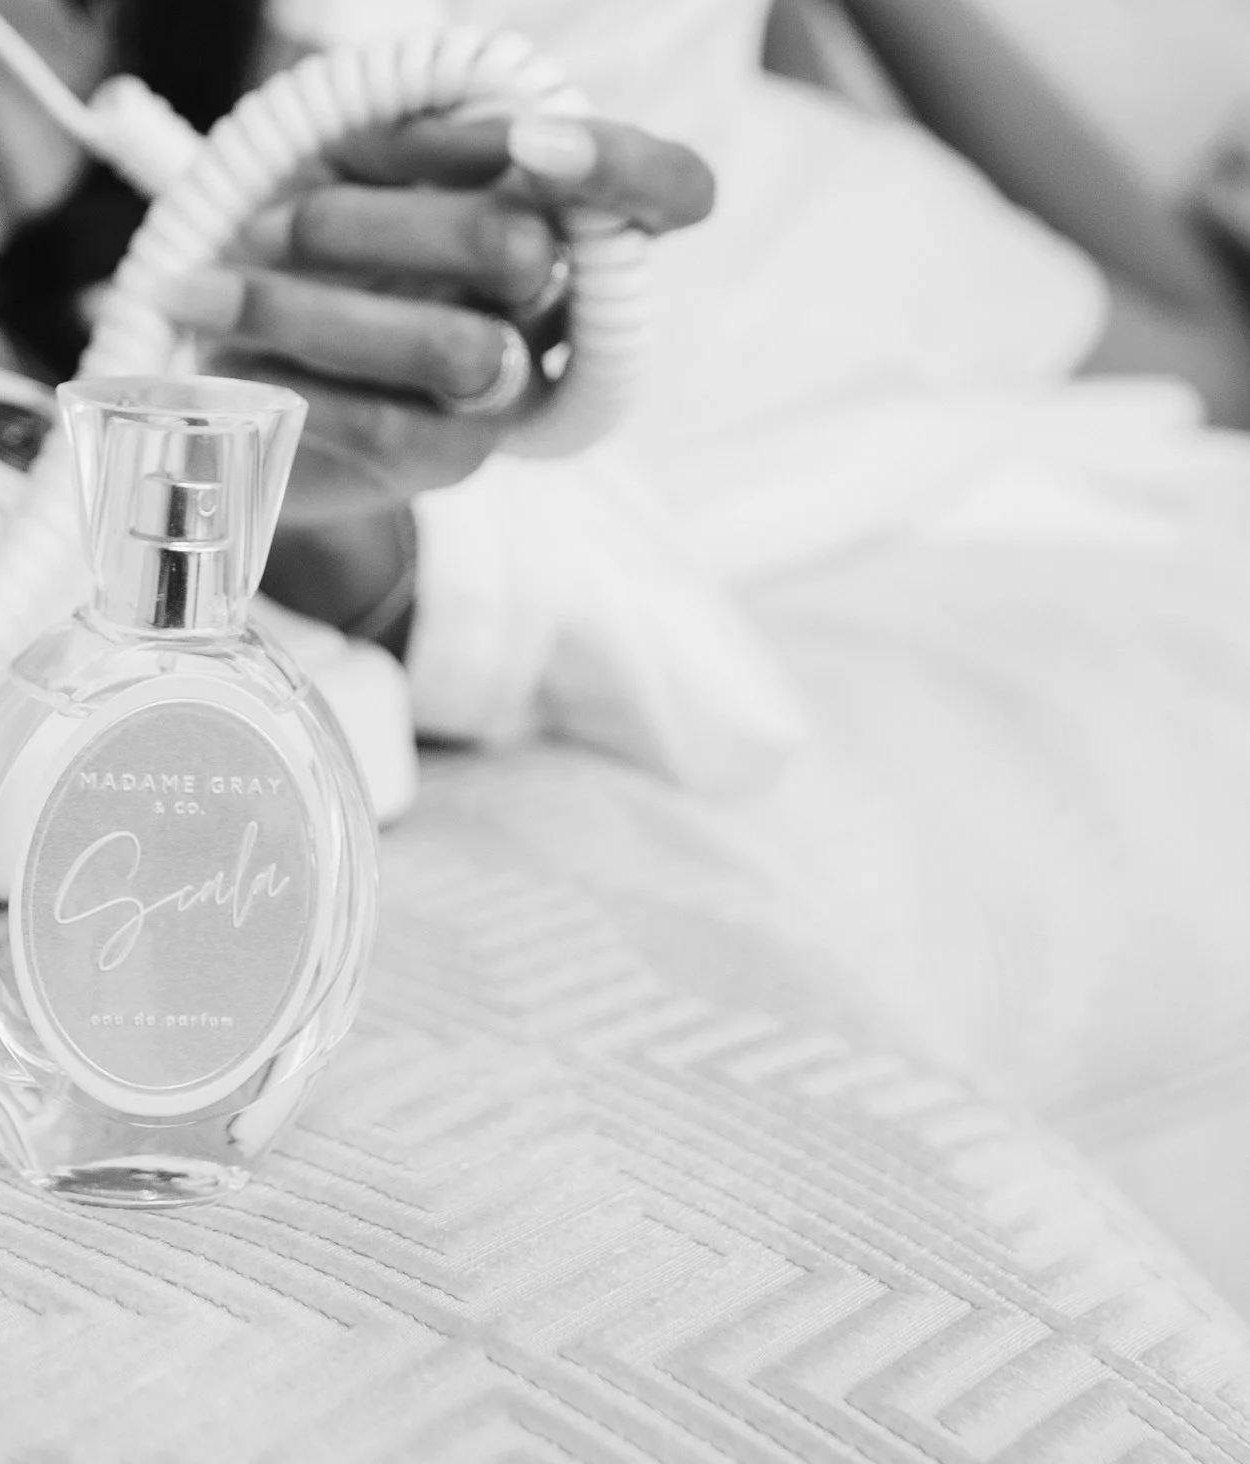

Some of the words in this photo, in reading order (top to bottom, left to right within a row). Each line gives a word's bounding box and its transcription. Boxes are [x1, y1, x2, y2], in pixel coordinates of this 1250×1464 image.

[78, 771, 196, 795] MADAME
[210, 775, 283, 796] GRAY
[152, 800, 166, 816] &
[173, 800, 206, 816] CO.
[53, 820, 291, 972] Scala
[90, 1013, 124, 1027] eau
[133, 1011, 156, 1027] de
[165, 1011, 234, 1029] parfum
